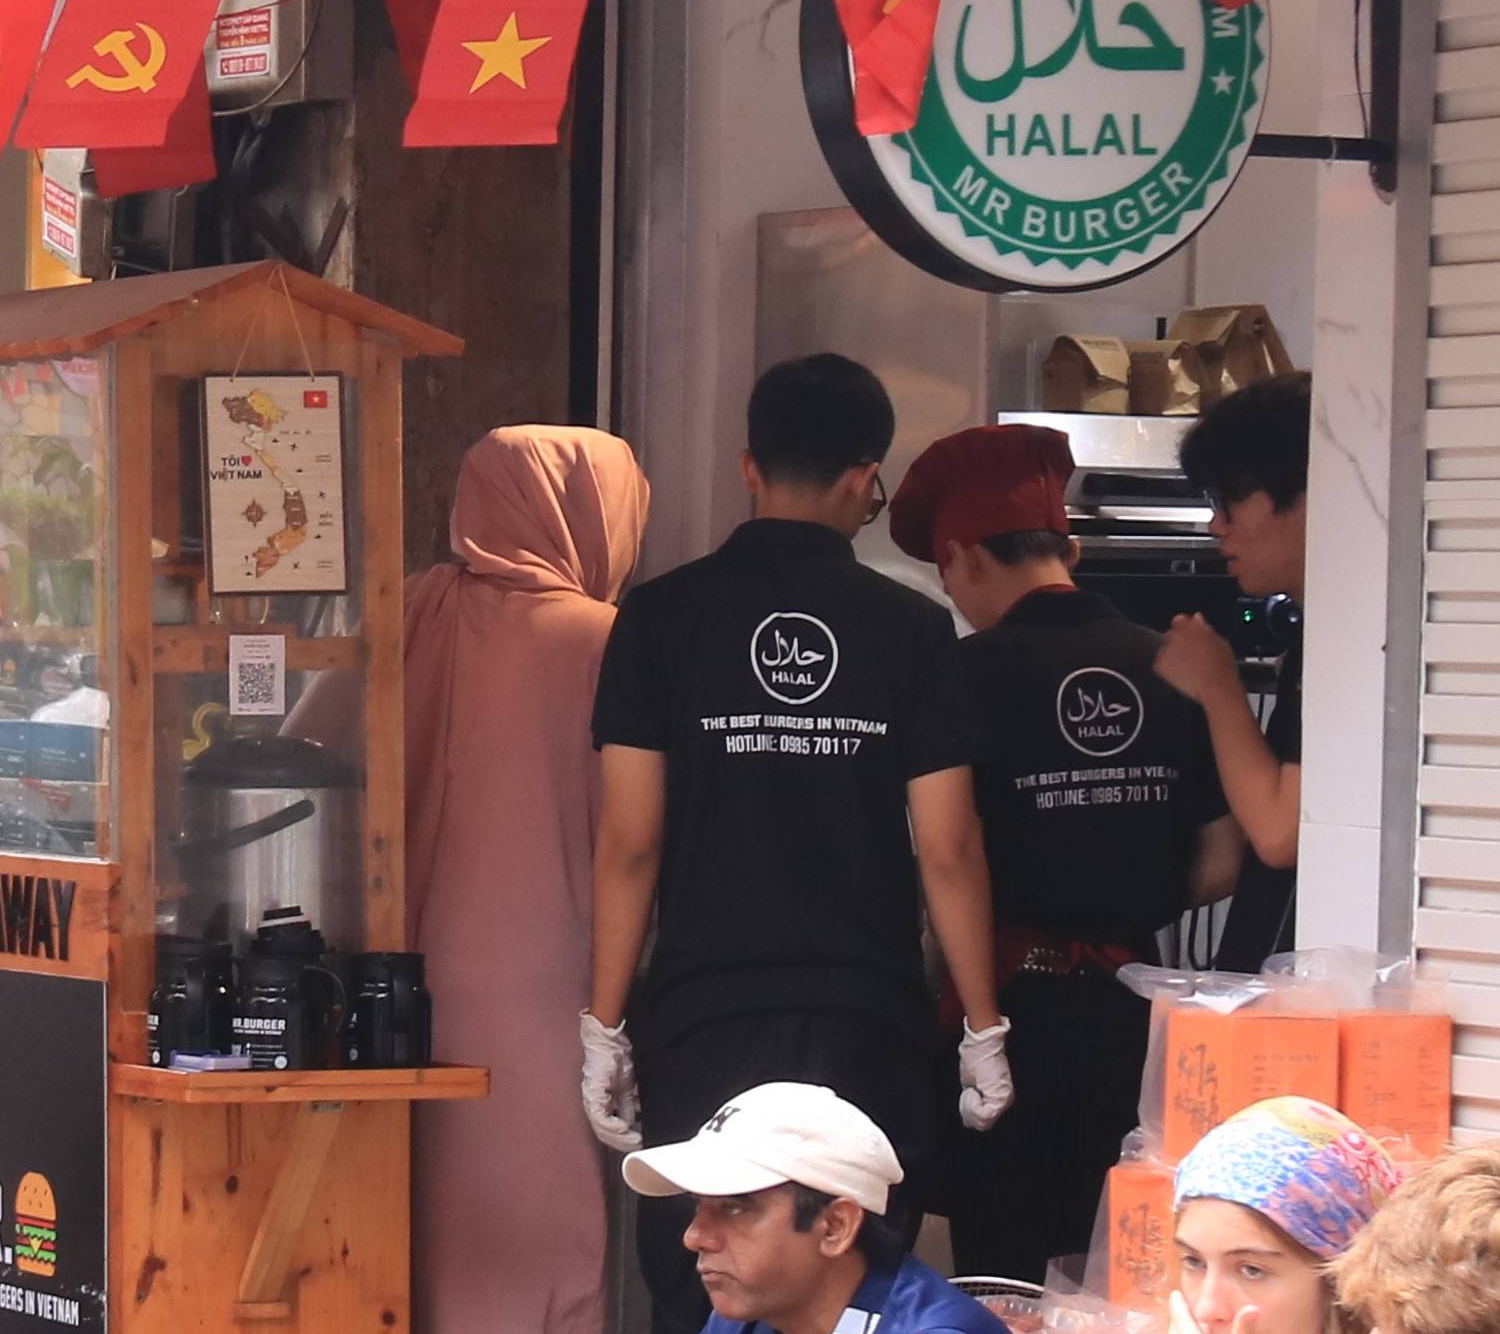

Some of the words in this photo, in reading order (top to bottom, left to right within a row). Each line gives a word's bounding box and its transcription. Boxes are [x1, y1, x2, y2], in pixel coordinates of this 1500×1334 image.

[984, 113, 1158, 157] HALAL
[951, 164, 1013, 227] MR
[1022, 160, 1194, 243] BURGER
[221, 454, 241, 467] TÔI
[209, 468, 235, 482] VIỆT
[237, 469, 262, 480] NAM
[761, 628, 826, 667] حلال
[771, 670, 816, 686] HALAL
[1067, 686, 1132, 722] حلال
[701, 717, 727, 731] THE
[729, 714, 762, 729] BEST
[763, 715, 814, 730] BURGERS
[817, 717, 832, 730] IN
[1078, 725, 1125, 739] HALAL
[1014, 775, 1038, 790] THE
[1038, 770, 1068, 786] BEST
[1128, 767, 1142, 779] IN
[25, 1289, 36, 1316] IN
[37, 1293, 80, 1326] VIETNAM
